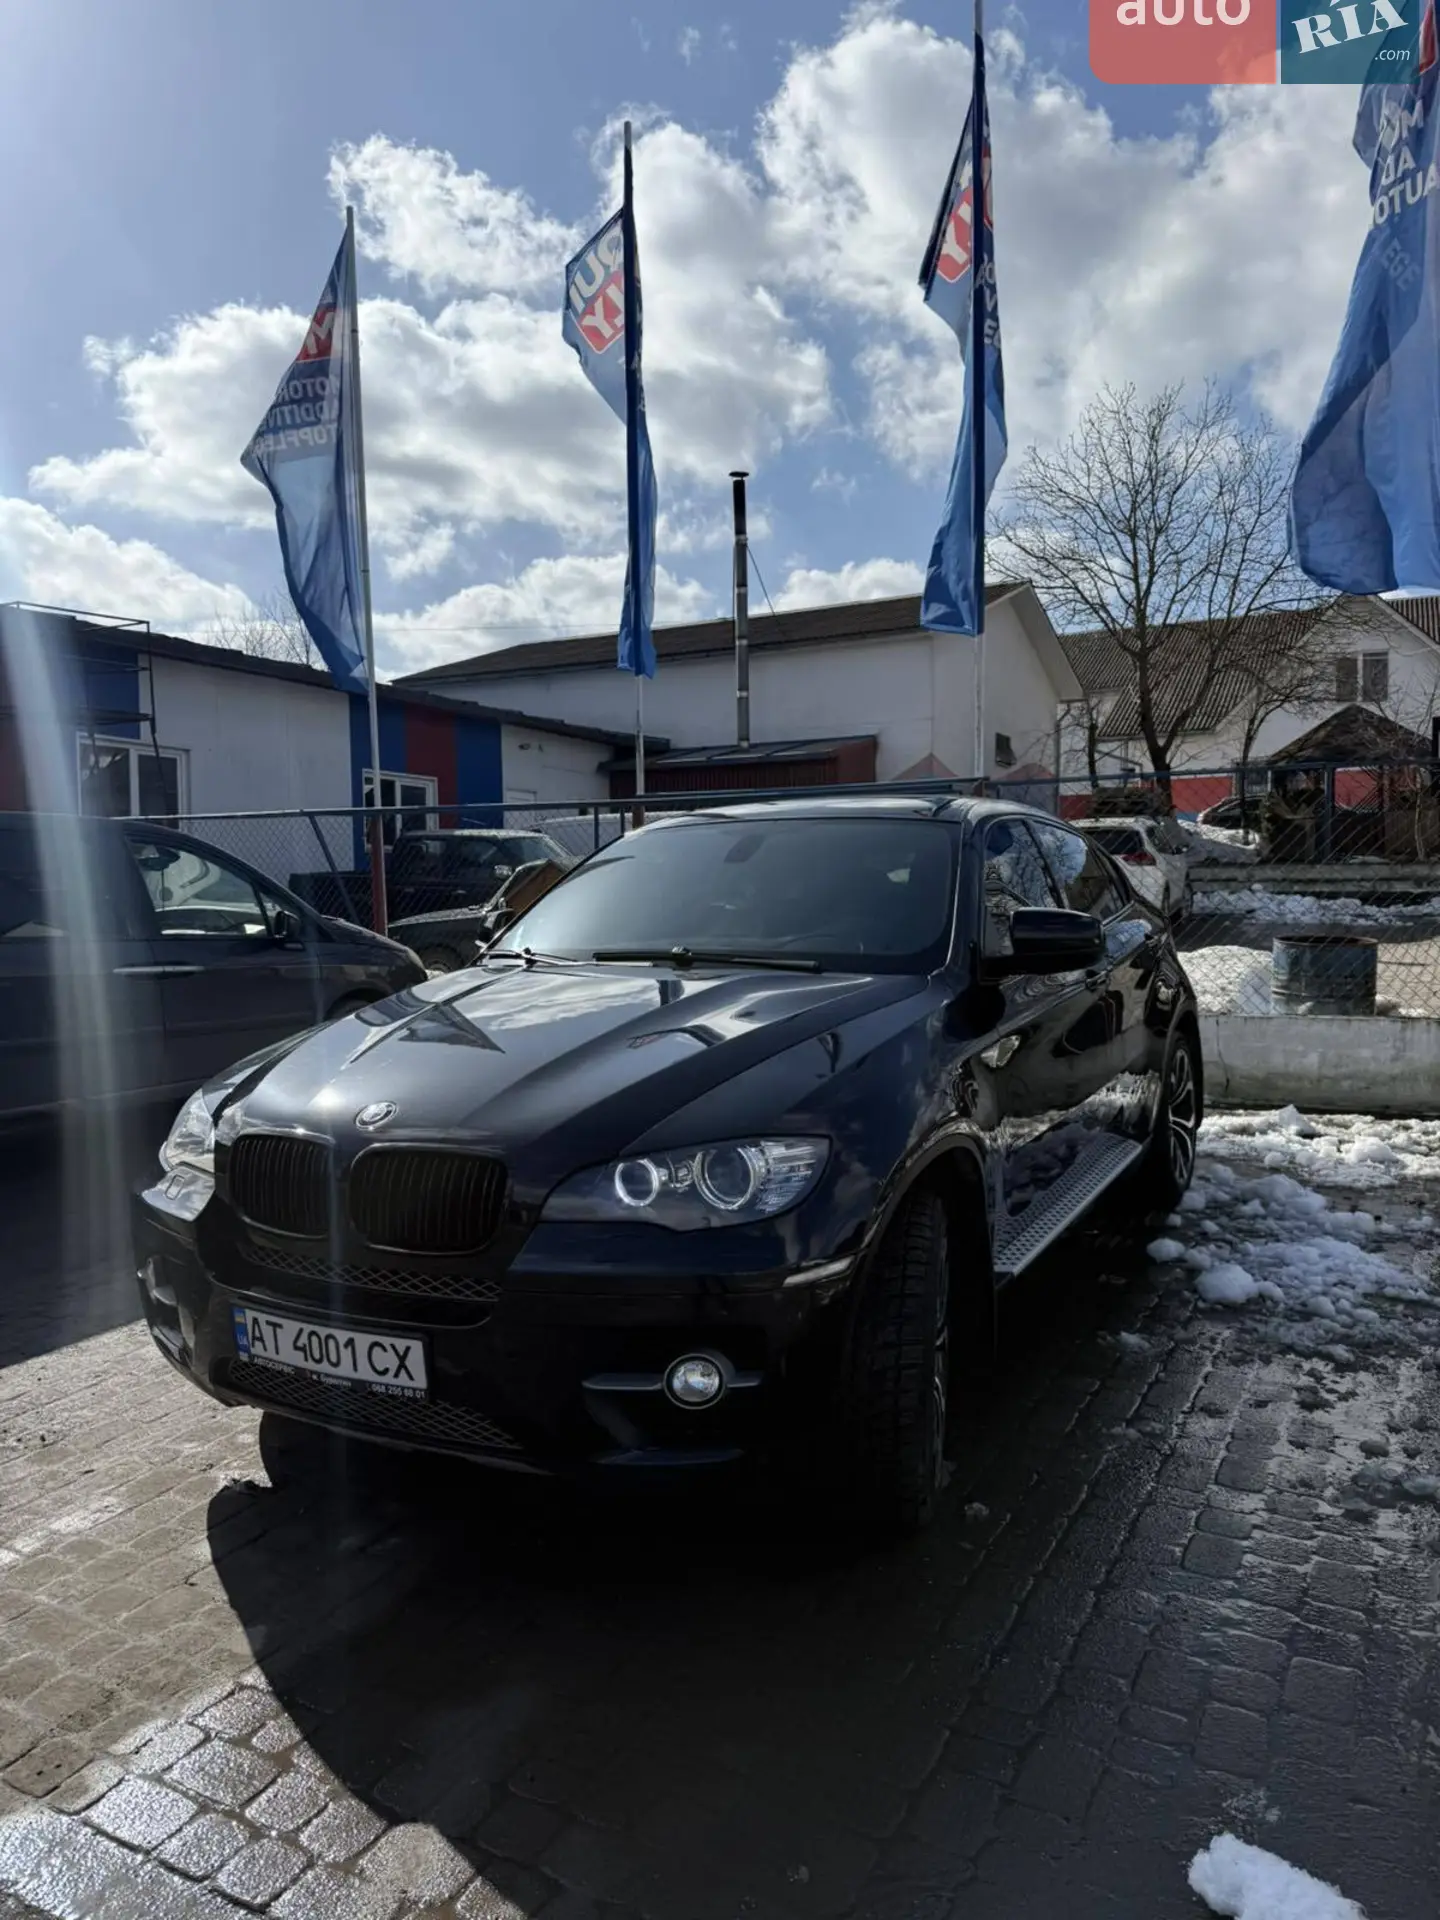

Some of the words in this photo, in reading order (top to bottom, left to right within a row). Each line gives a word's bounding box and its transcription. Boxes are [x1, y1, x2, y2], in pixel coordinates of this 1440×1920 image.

[251, 1316, 284, 1356] AT
[292, 1327, 358, 1373] 4001
[367, 1340, 415, 1382] CX
